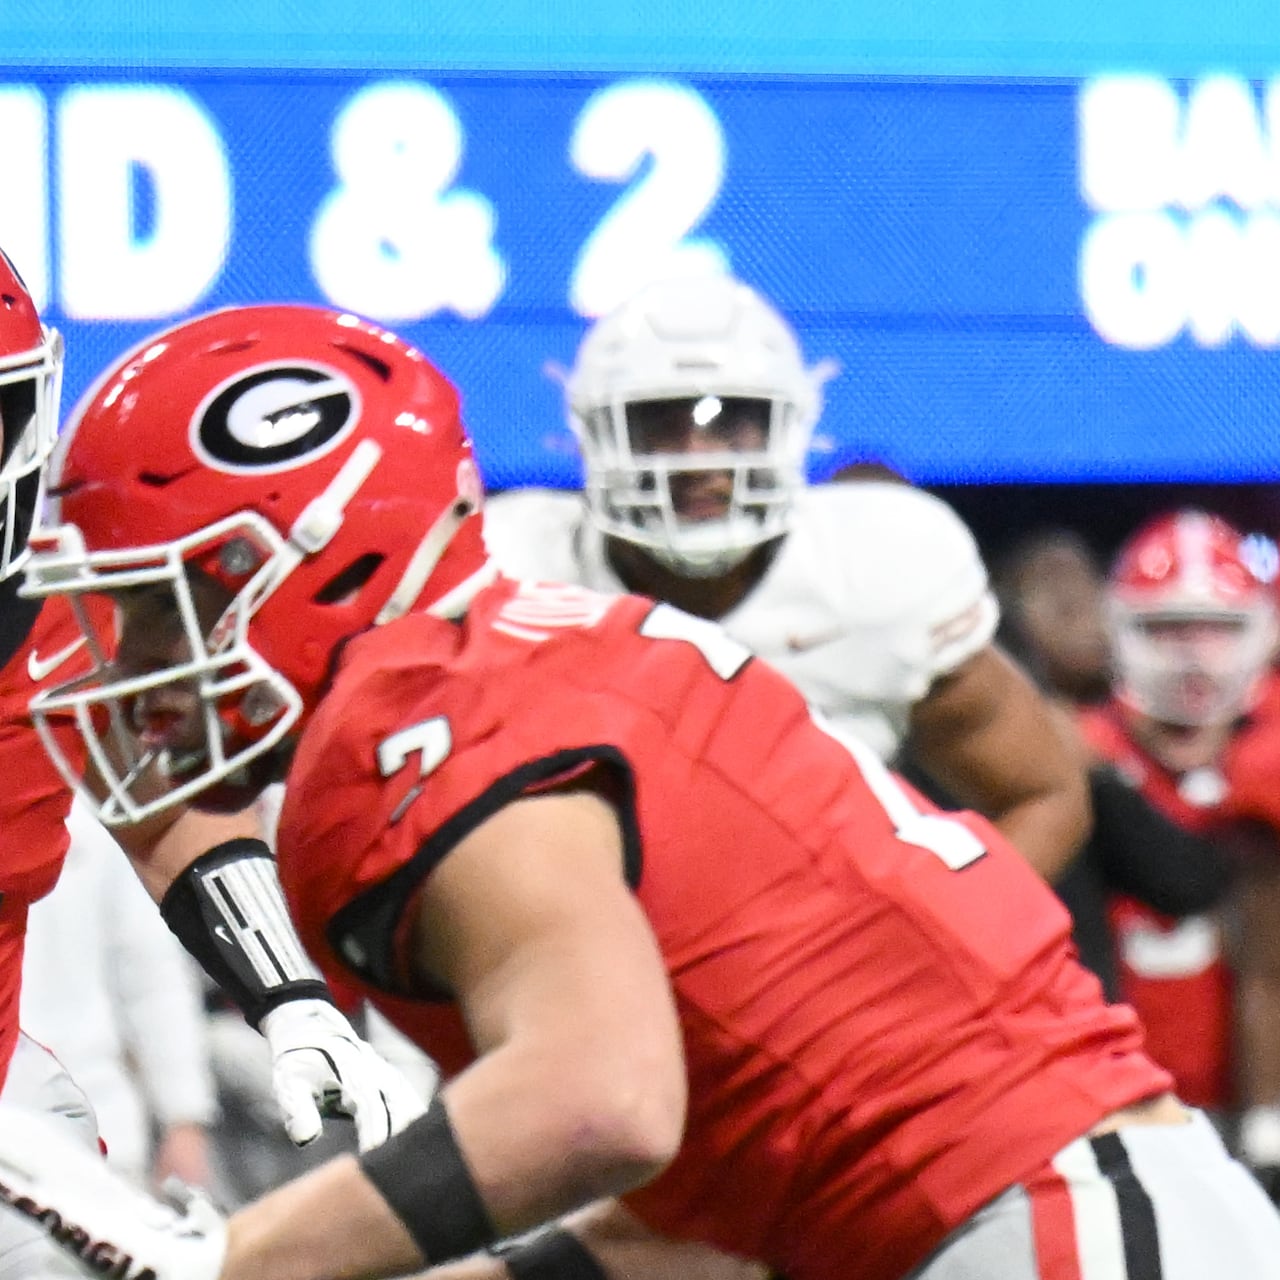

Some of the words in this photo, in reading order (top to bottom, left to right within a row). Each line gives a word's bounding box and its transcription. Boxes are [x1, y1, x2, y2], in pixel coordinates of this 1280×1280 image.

[0, 82, 235, 320] D
[308, 78, 508, 322] &
[568, 78, 731, 320] 2
[208, 366, 357, 462] G
